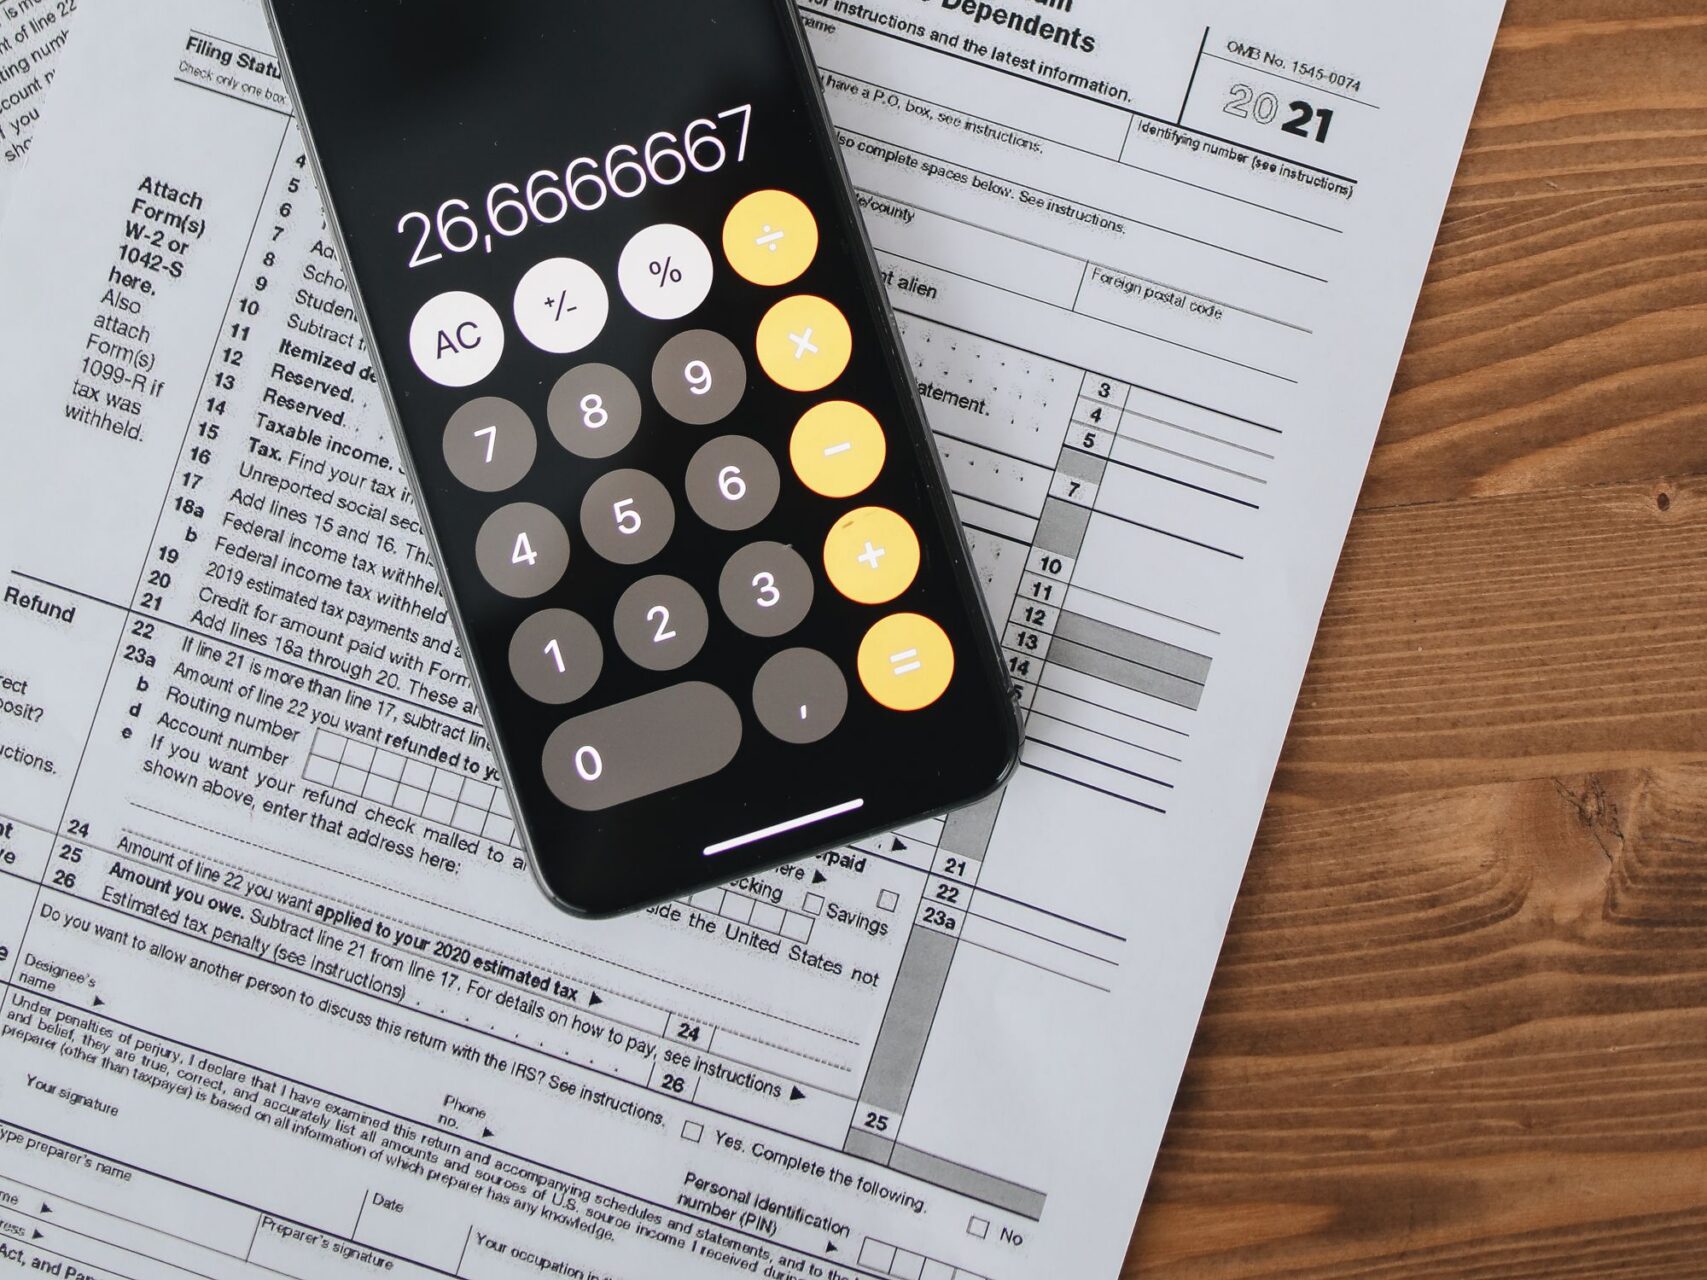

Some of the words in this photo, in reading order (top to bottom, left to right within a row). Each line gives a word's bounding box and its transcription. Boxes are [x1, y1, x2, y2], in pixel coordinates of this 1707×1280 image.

[184, 34, 234, 67] Filing
[928, 29, 961, 49] and
[961, 37, 989, 57] the
[989, 45, 1036, 73] latest
[1036, 60, 1132, 103] information.
[1225, 39, 1261, 61] OMB
[1262, 50, 1286, 69] No.
[1292, 59, 1362, 93] 1545-0074
[1136, 118, 1201, 152] Identifying
[1201, 141, 1250, 164] number
[136, 175, 204, 211] Attach
[397, 104, 752, 268] 26,6666667
[130, 196, 206, 240] Form(s)
[124, 218, 165, 249] W-2
[166, 238, 190, 256] or
[118, 243, 185, 280] 1042-S
[648, 255, 683, 287] %
[107, 264, 156, 297] here.
[1090, 266, 1142, 295] Foreign
[1142, 286, 1187, 308] postal
[1188, 300, 1223, 321] code
[99, 287, 142, 315] Also
[92, 313, 151, 344] attach
[436, 321, 482, 360] AC
[85, 331, 156, 373] Form(s)
[277, 337, 357, 377] Itemized
[81, 355, 148, 393] 1099-R
[148, 378, 166, 398] if
[269, 361, 355, 404] Reserved.
[684, 360, 713, 395] 9
[1096, 381, 1112, 399] 3
[71, 377, 101, 403] tax
[105, 392, 142, 416] was
[579, 394, 608, 429] 8
[64, 403, 144, 443] withheld.
[255, 410, 323, 447] Taxable
[325, 434, 393, 471] income.
[474, 426, 497, 463] 7
[718, 466, 746, 501] 6
[1067, 480, 1081, 498] 7
[613, 498, 642, 534] 5
[511, 532, 537, 567] 4
[3, 585, 77, 624] Refund
[751, 571, 781, 607] 3
[646, 606, 677, 643] 2
[544, 639, 566, 673] 1
[165, 684, 232, 723] Routing
[233, 710, 301, 743] number
[574, 745, 603, 781] 0
[57, 843, 84, 864] 25
[106, 860, 173, 895] Amount
[171, 884, 205, 906] you
[206, 897, 245, 920] owe.
[825, 901, 889, 937] Savings
[921, 905, 956, 931] 23a
[313, 903, 378, 933] applied
[374, 920, 391, 939] to
[391, 929, 432, 952] your
[432, 939, 472, 966] 2020
[471, 956, 552, 993] estimated
[552, 979, 579, 1003] tax
[687, 911, 717, 934] the
[724, 921, 782, 956] United
[787, 943, 843, 976] States
[849, 967, 880, 988] not
[23, 952, 97, 988] Designee's
[675, 1021, 701, 1043] 24
[26, 1072, 57, 1095] Your
[57, 1087, 119, 1117] signature
[441, 1093, 487, 1120] Phone
[436, 1113, 459, 1130] no.
[715, 1128, 745, 1153] Yes.
[371, 1191, 405, 1214] Date
[682, 1170, 753, 1205] Personal
[675, 1192, 738, 1222] number
[738, 1210, 778, 1238] (PIN)
[260, 1214, 330, 1249] Preparer's
[331, 1241, 395, 1271] signature
[999, 1225, 1024, 1247] No
